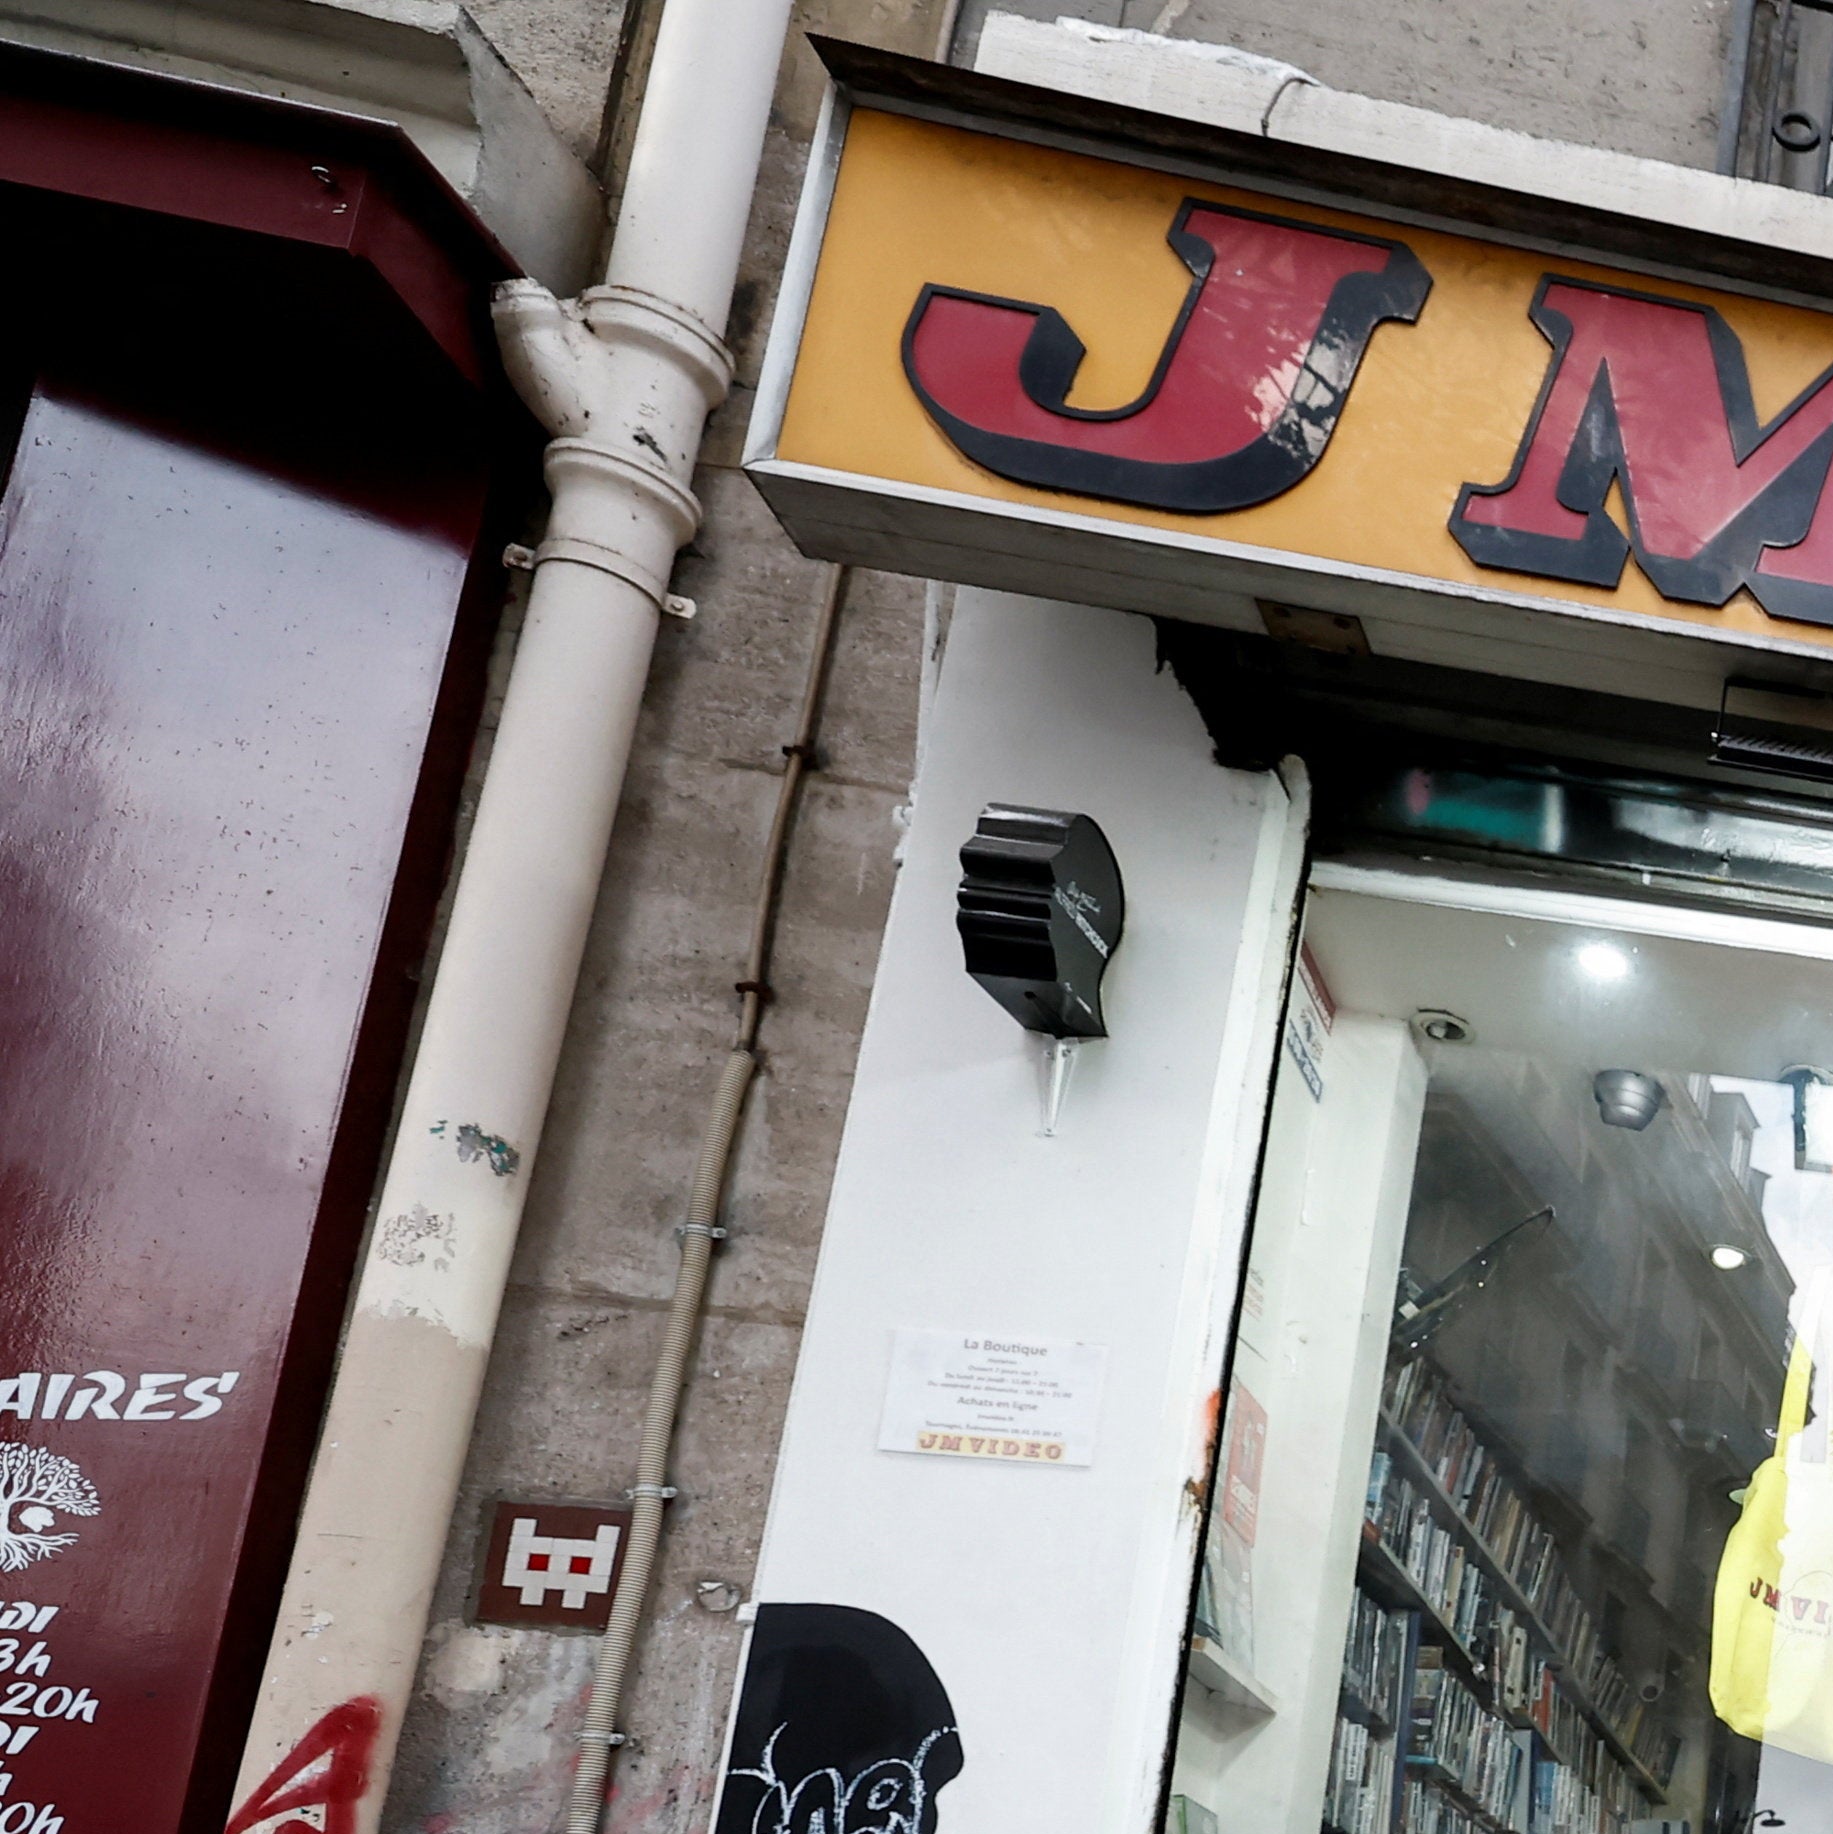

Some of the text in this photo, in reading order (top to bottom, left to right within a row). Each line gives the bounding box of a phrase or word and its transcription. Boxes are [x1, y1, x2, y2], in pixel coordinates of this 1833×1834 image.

[963, 1338, 1048, 1357] La Boutique
[957, 1396, 994, 1408] Achats
[918, 1433, 1064, 1460] JM VIDEO
